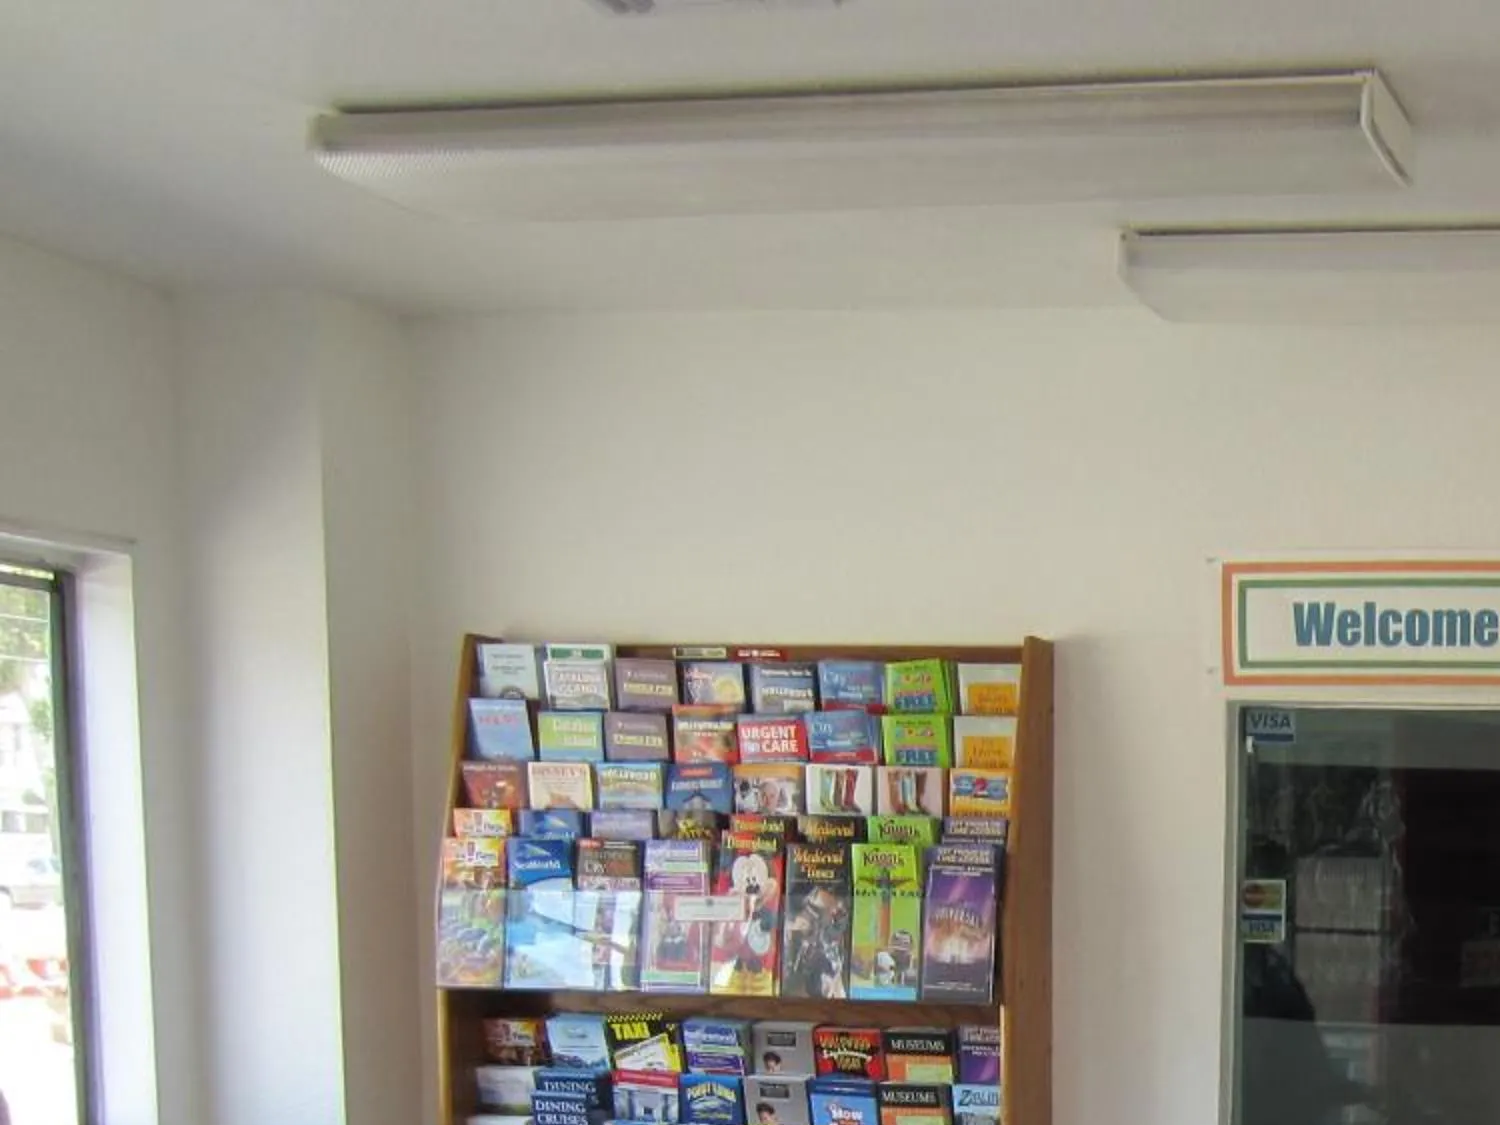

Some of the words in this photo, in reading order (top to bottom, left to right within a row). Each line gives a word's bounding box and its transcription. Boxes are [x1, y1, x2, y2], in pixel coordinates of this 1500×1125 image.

[1293, 602, 1499, 647] Welcome
[1250, 712, 1291, 729] VISA
[741, 725, 798, 739] URGENT
[761, 740, 799, 753] CARE
[611, 1022, 650, 1041] TAXI
[891, 1038, 946, 1052] MUSEUMS
[544, 1081, 597, 1093] DINING
[882, 1090, 937, 1104] MUSEUMS
[535, 1099, 587, 1113] DINING
